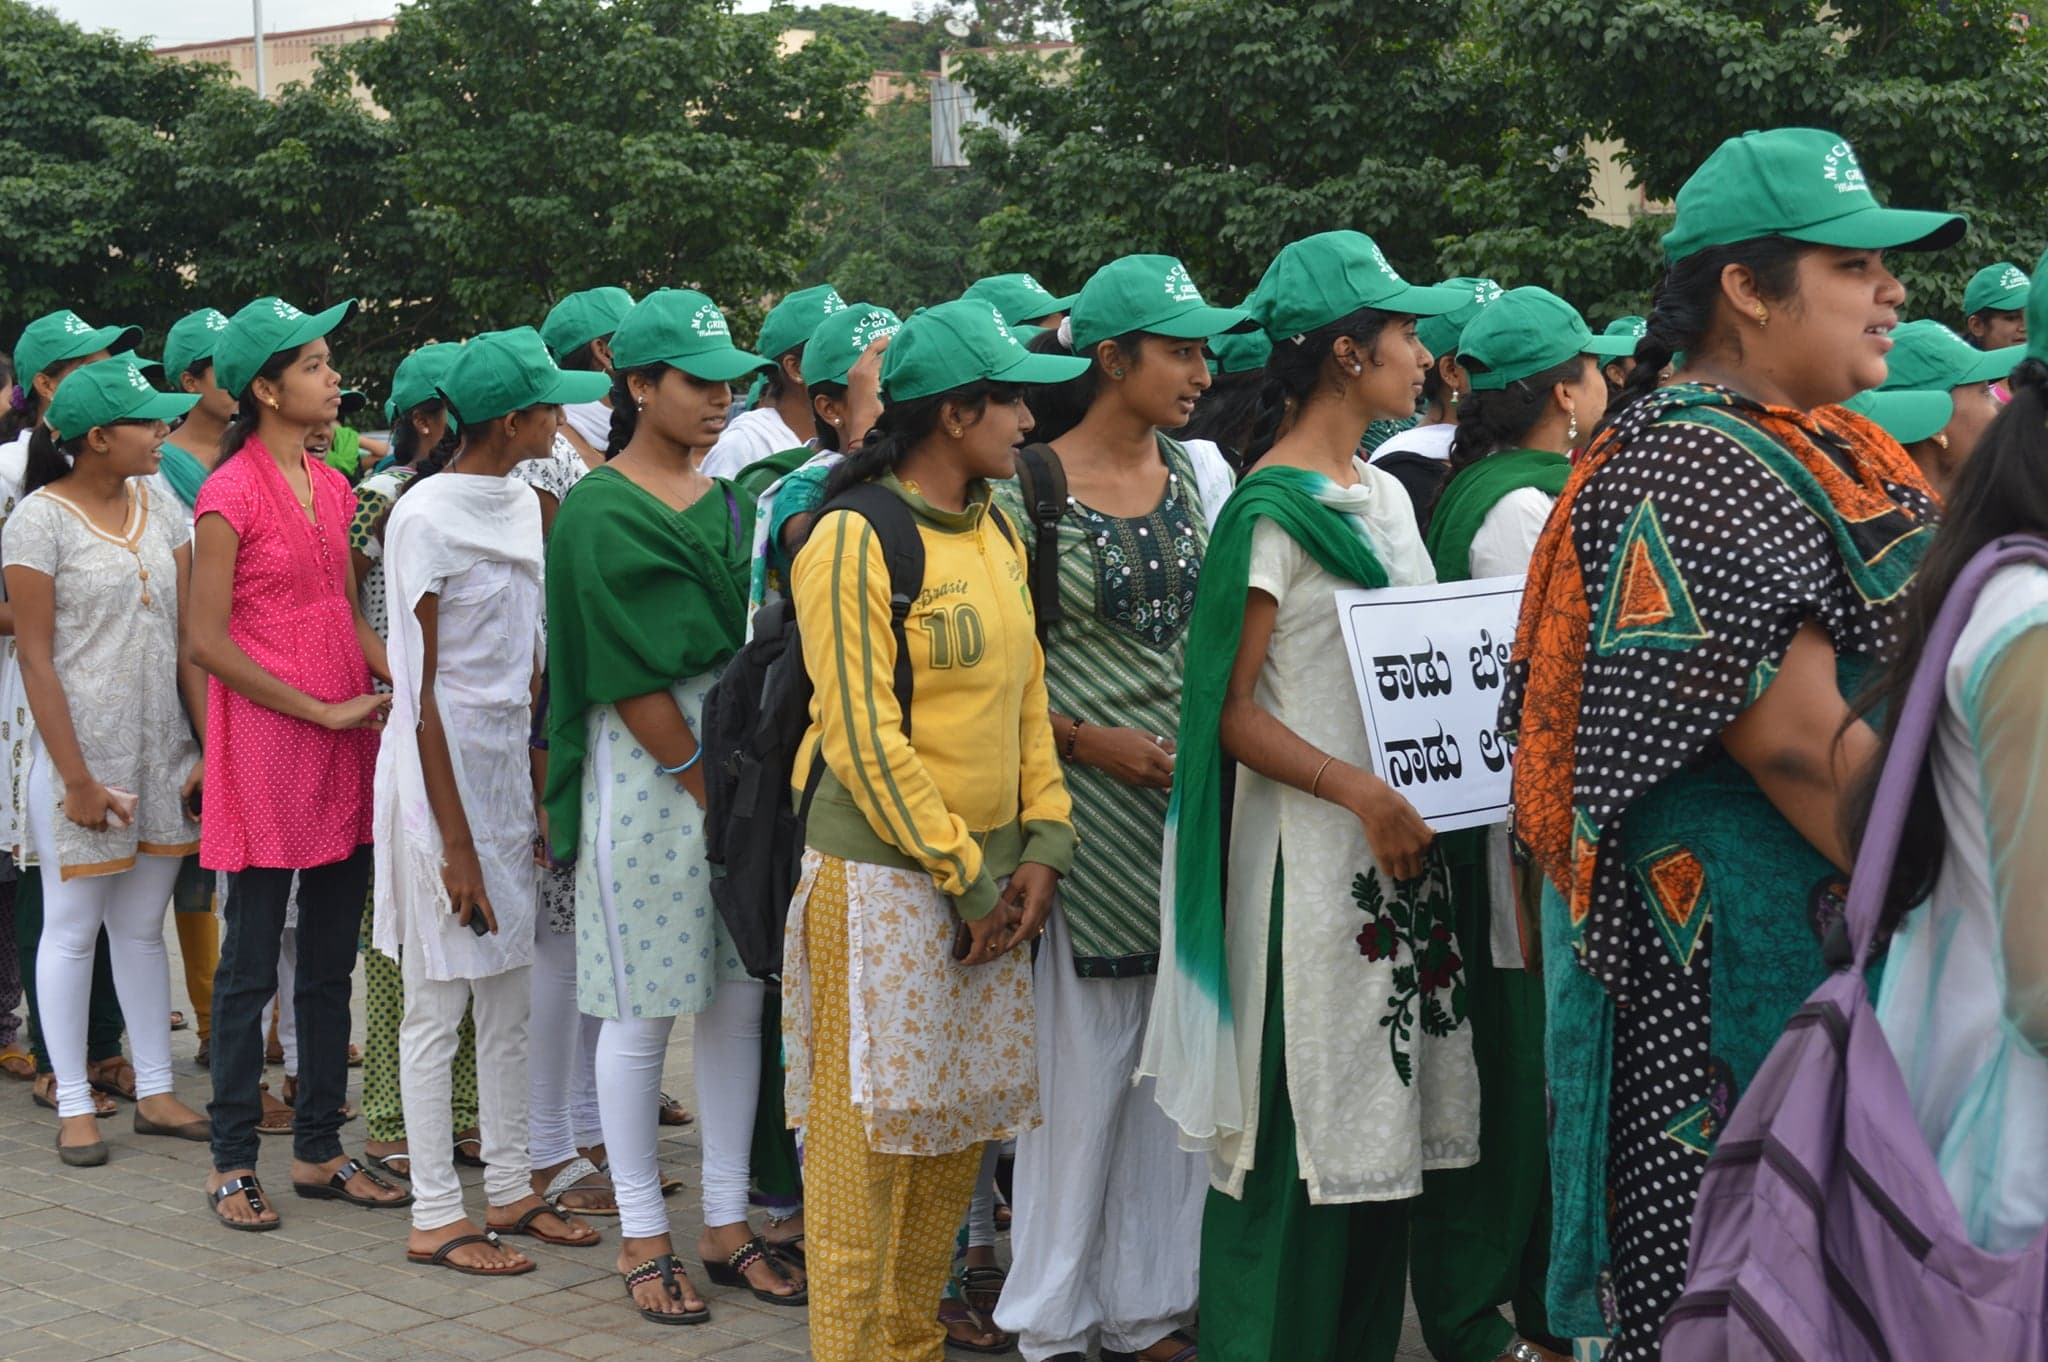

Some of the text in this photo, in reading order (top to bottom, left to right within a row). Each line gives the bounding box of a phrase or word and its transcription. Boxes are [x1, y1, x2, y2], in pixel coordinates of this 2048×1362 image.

[871, 318, 887, 329] GO
[917, 579, 968, 607] Brasil
[920, 603, 985, 669] 10
[1373, 635, 1451, 701] ಕಾಡು
[1384, 719, 1462, 788] ನಾಡು
